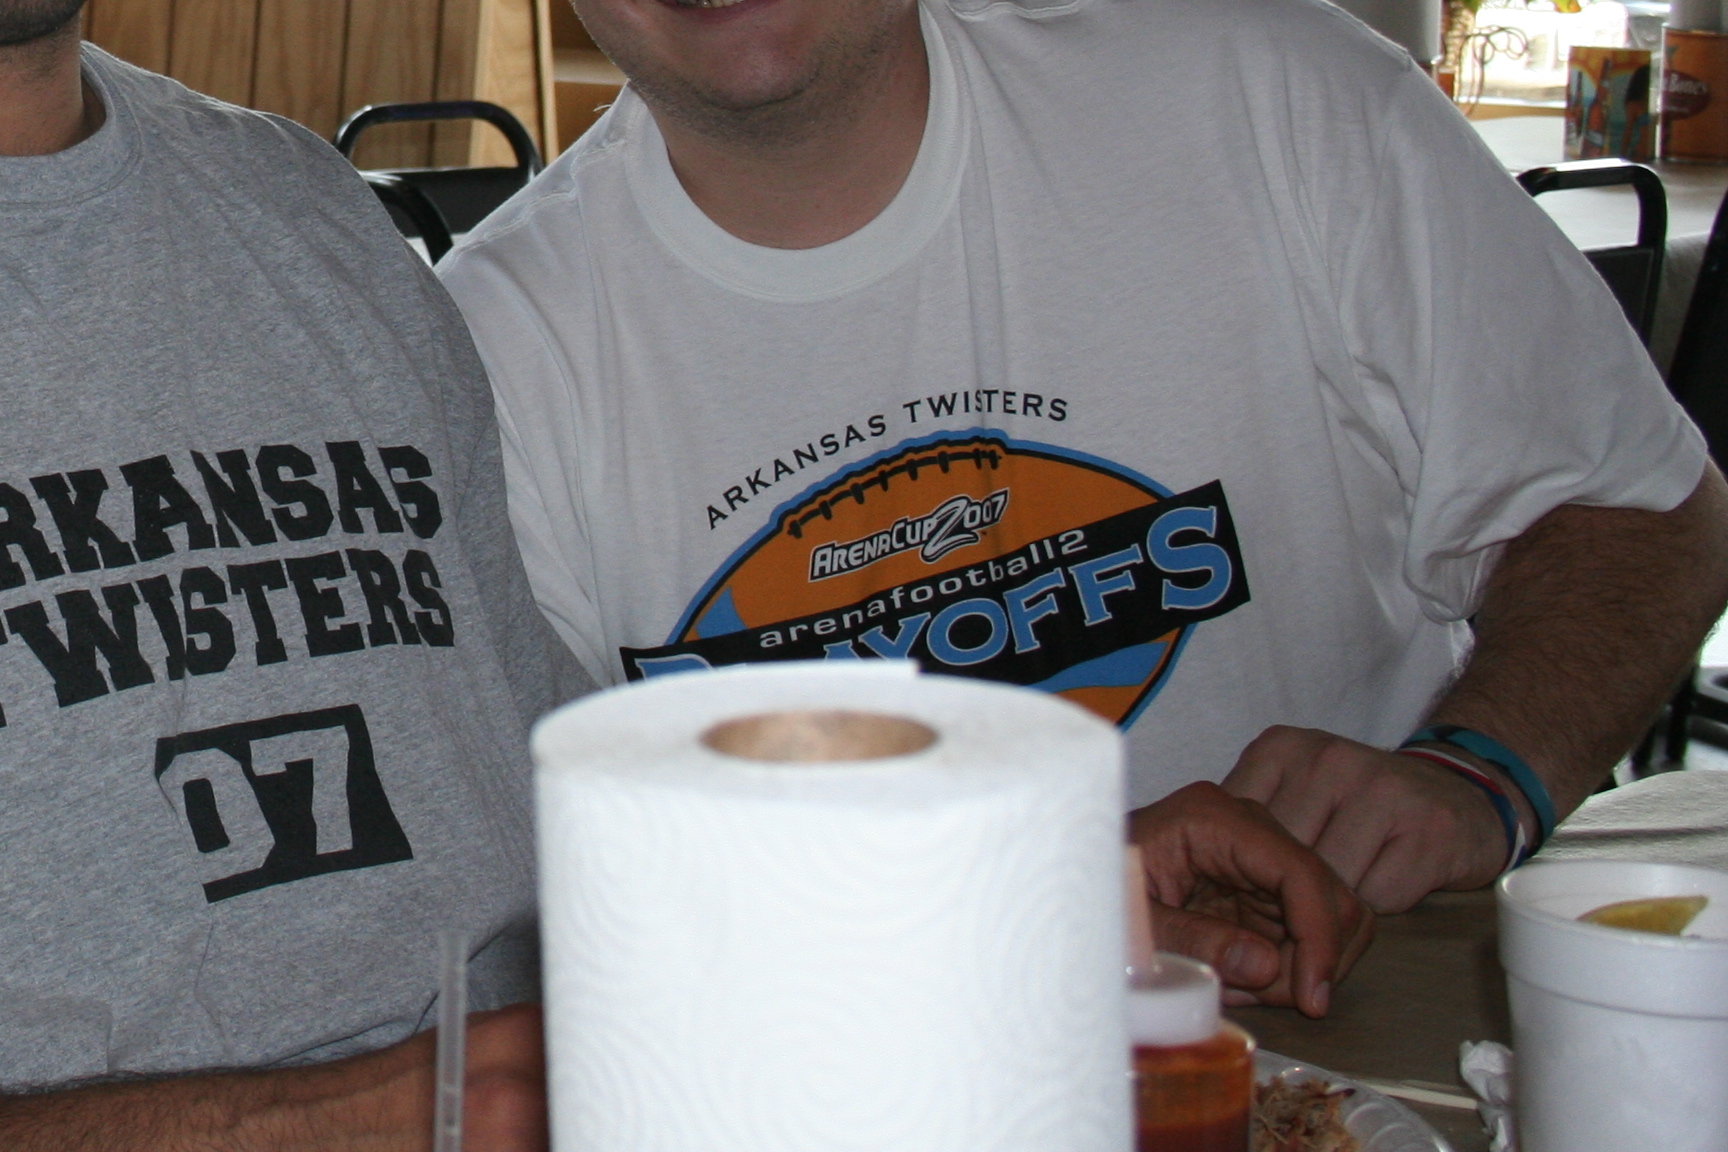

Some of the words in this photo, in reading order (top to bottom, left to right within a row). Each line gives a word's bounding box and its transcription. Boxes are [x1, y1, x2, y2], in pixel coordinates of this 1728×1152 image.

[706, 414, 887, 530] ARKANSAS
[903, 389, 1068, 423] TWISTERS
[634, 506, 1232, 680] YOFFS
[759, 529, 1088, 649] arenafootball2
[158, 724, 356, 872] 07
